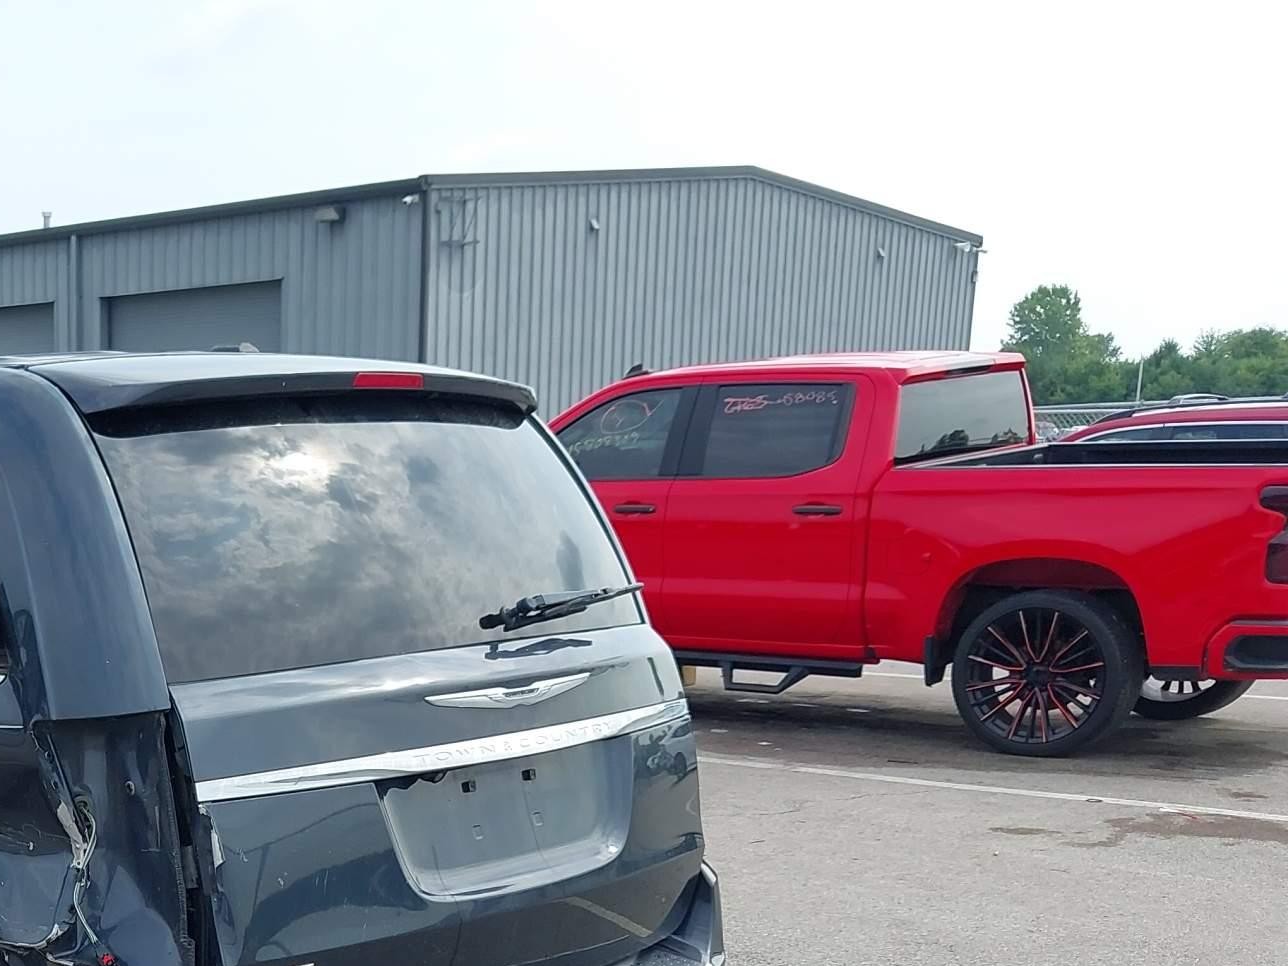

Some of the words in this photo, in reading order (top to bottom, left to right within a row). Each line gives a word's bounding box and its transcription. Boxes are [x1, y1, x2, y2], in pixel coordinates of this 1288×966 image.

[414, 743, 496, 768] TOWN
[502, 740, 514, 752] &
[518, 720, 616, 749] COUNTRY
